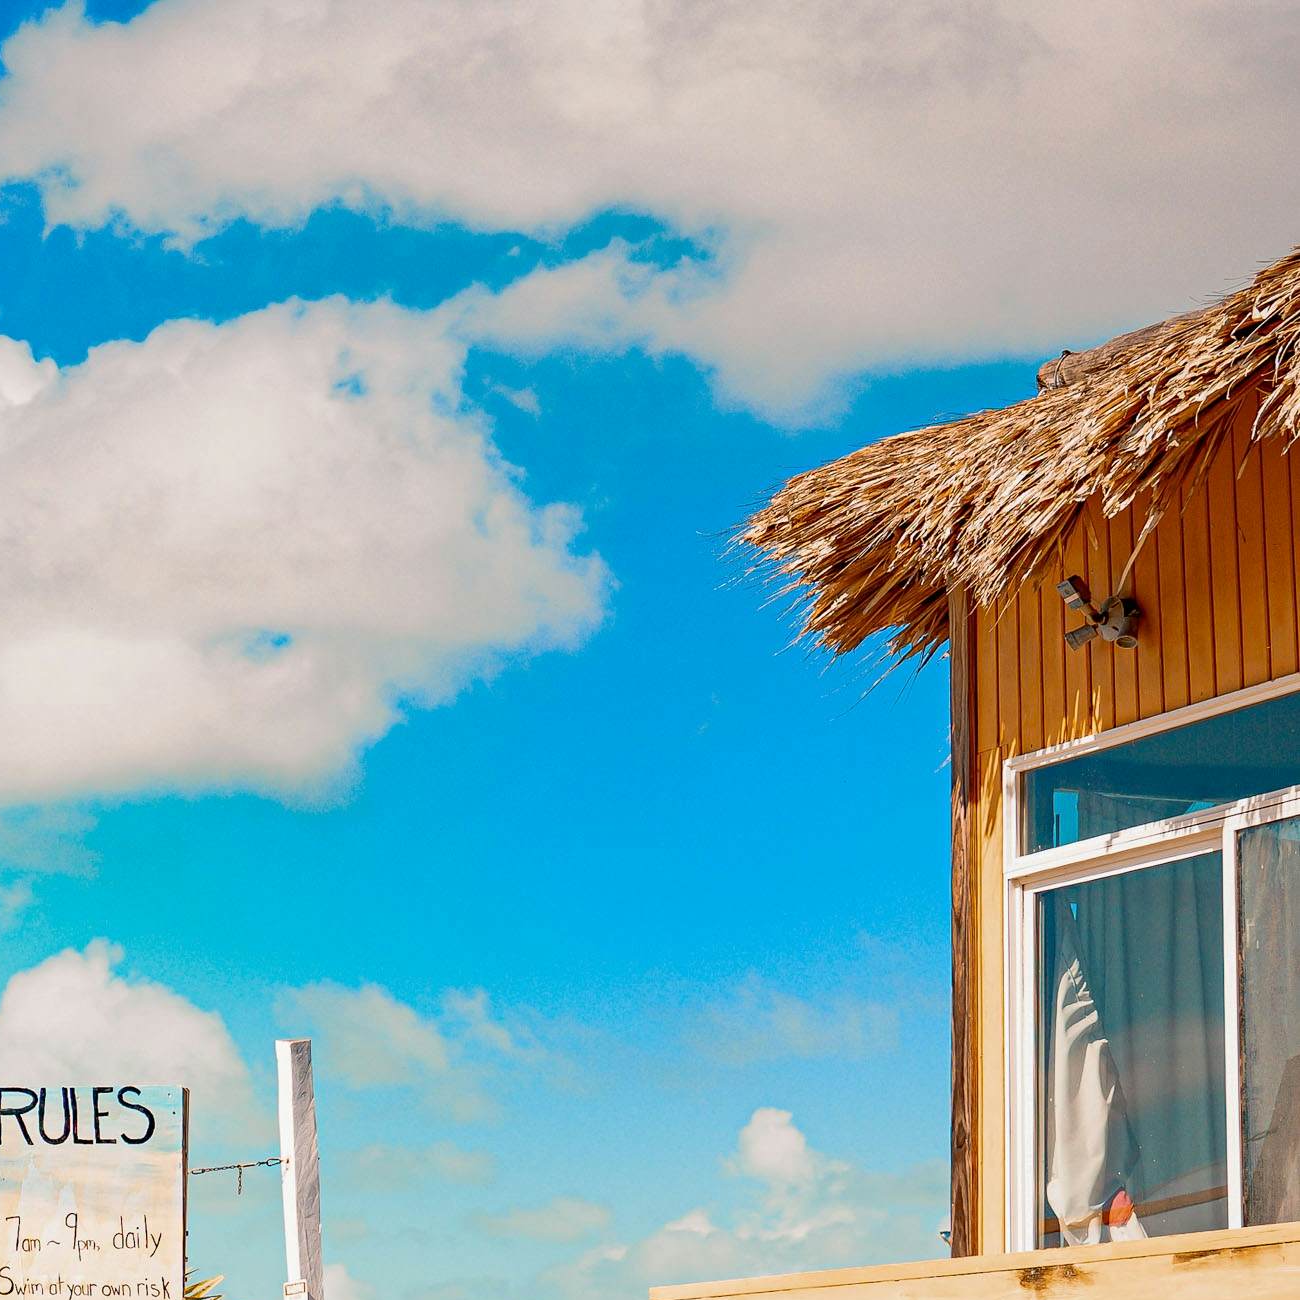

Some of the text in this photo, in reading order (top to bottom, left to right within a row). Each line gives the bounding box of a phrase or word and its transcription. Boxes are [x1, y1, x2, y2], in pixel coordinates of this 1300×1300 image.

[5, 1215, 41, 1252] 7am
[112, 1216, 162, 1258] daily
[49, 1272, 64, 1296] at
[102, 1284, 132, 1297] own
[136, 1276, 171, 1300] risk
